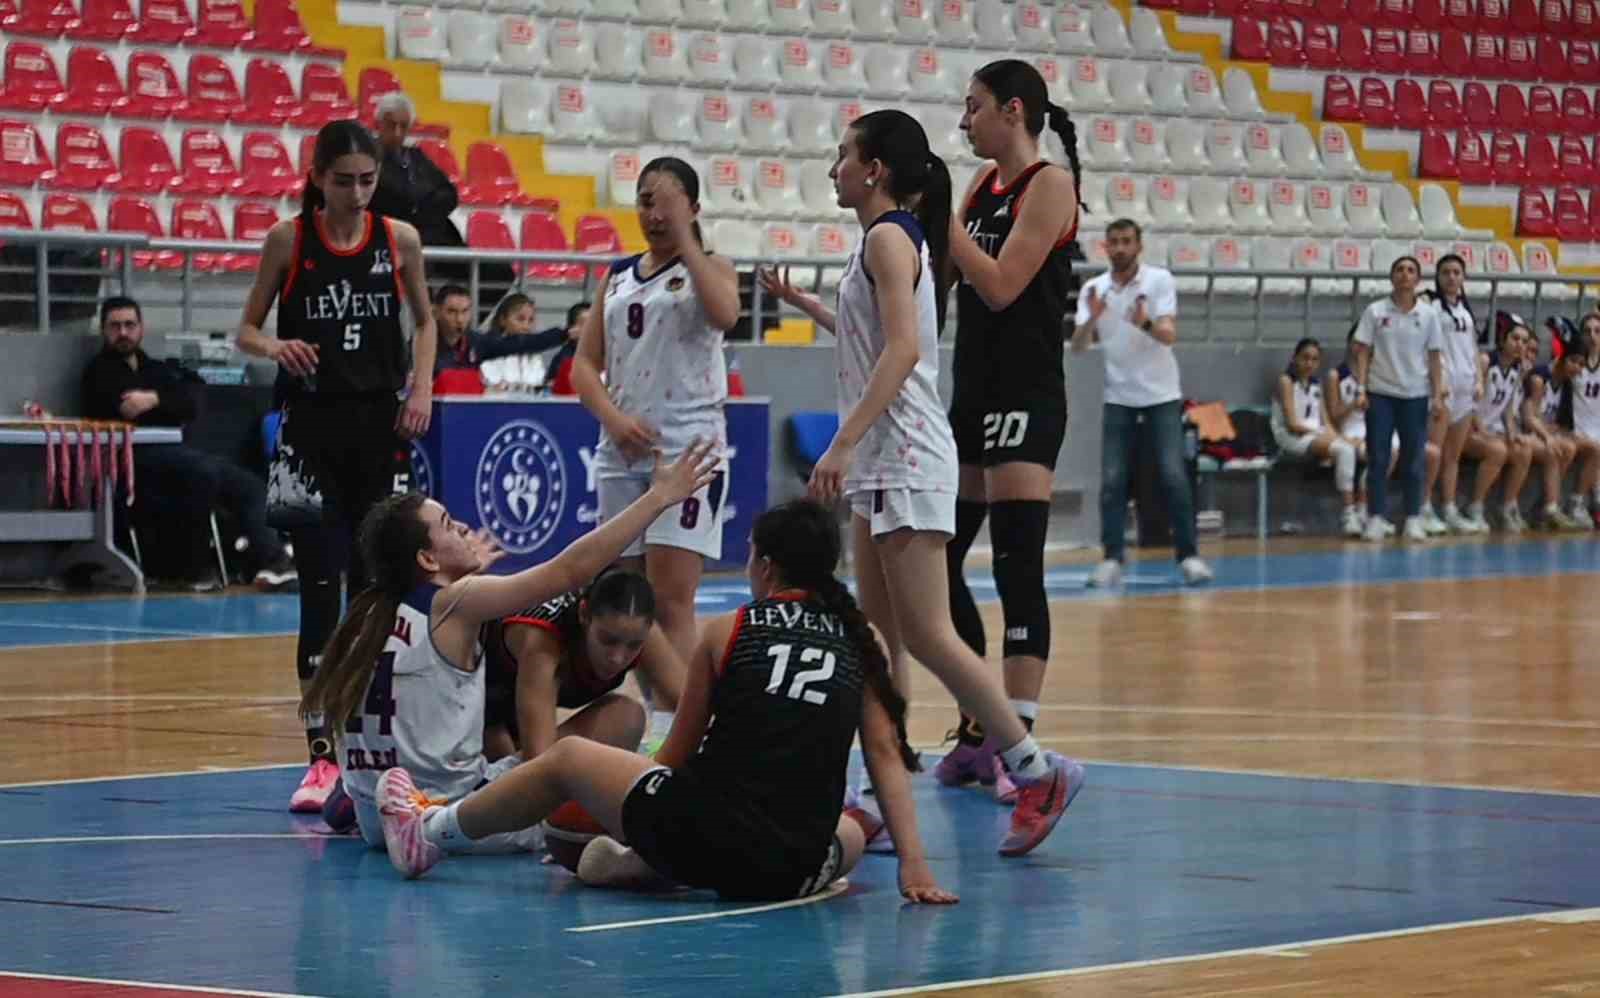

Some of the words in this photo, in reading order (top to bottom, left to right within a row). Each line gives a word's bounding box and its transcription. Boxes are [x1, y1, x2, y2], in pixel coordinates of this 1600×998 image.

[305, 279, 392, 320] LEVENT
[343, 323, 361, 350] 5
[983, 410, 1029, 451] 20
[392, 472, 409, 496] 5
[764, 643, 837, 705] 12
